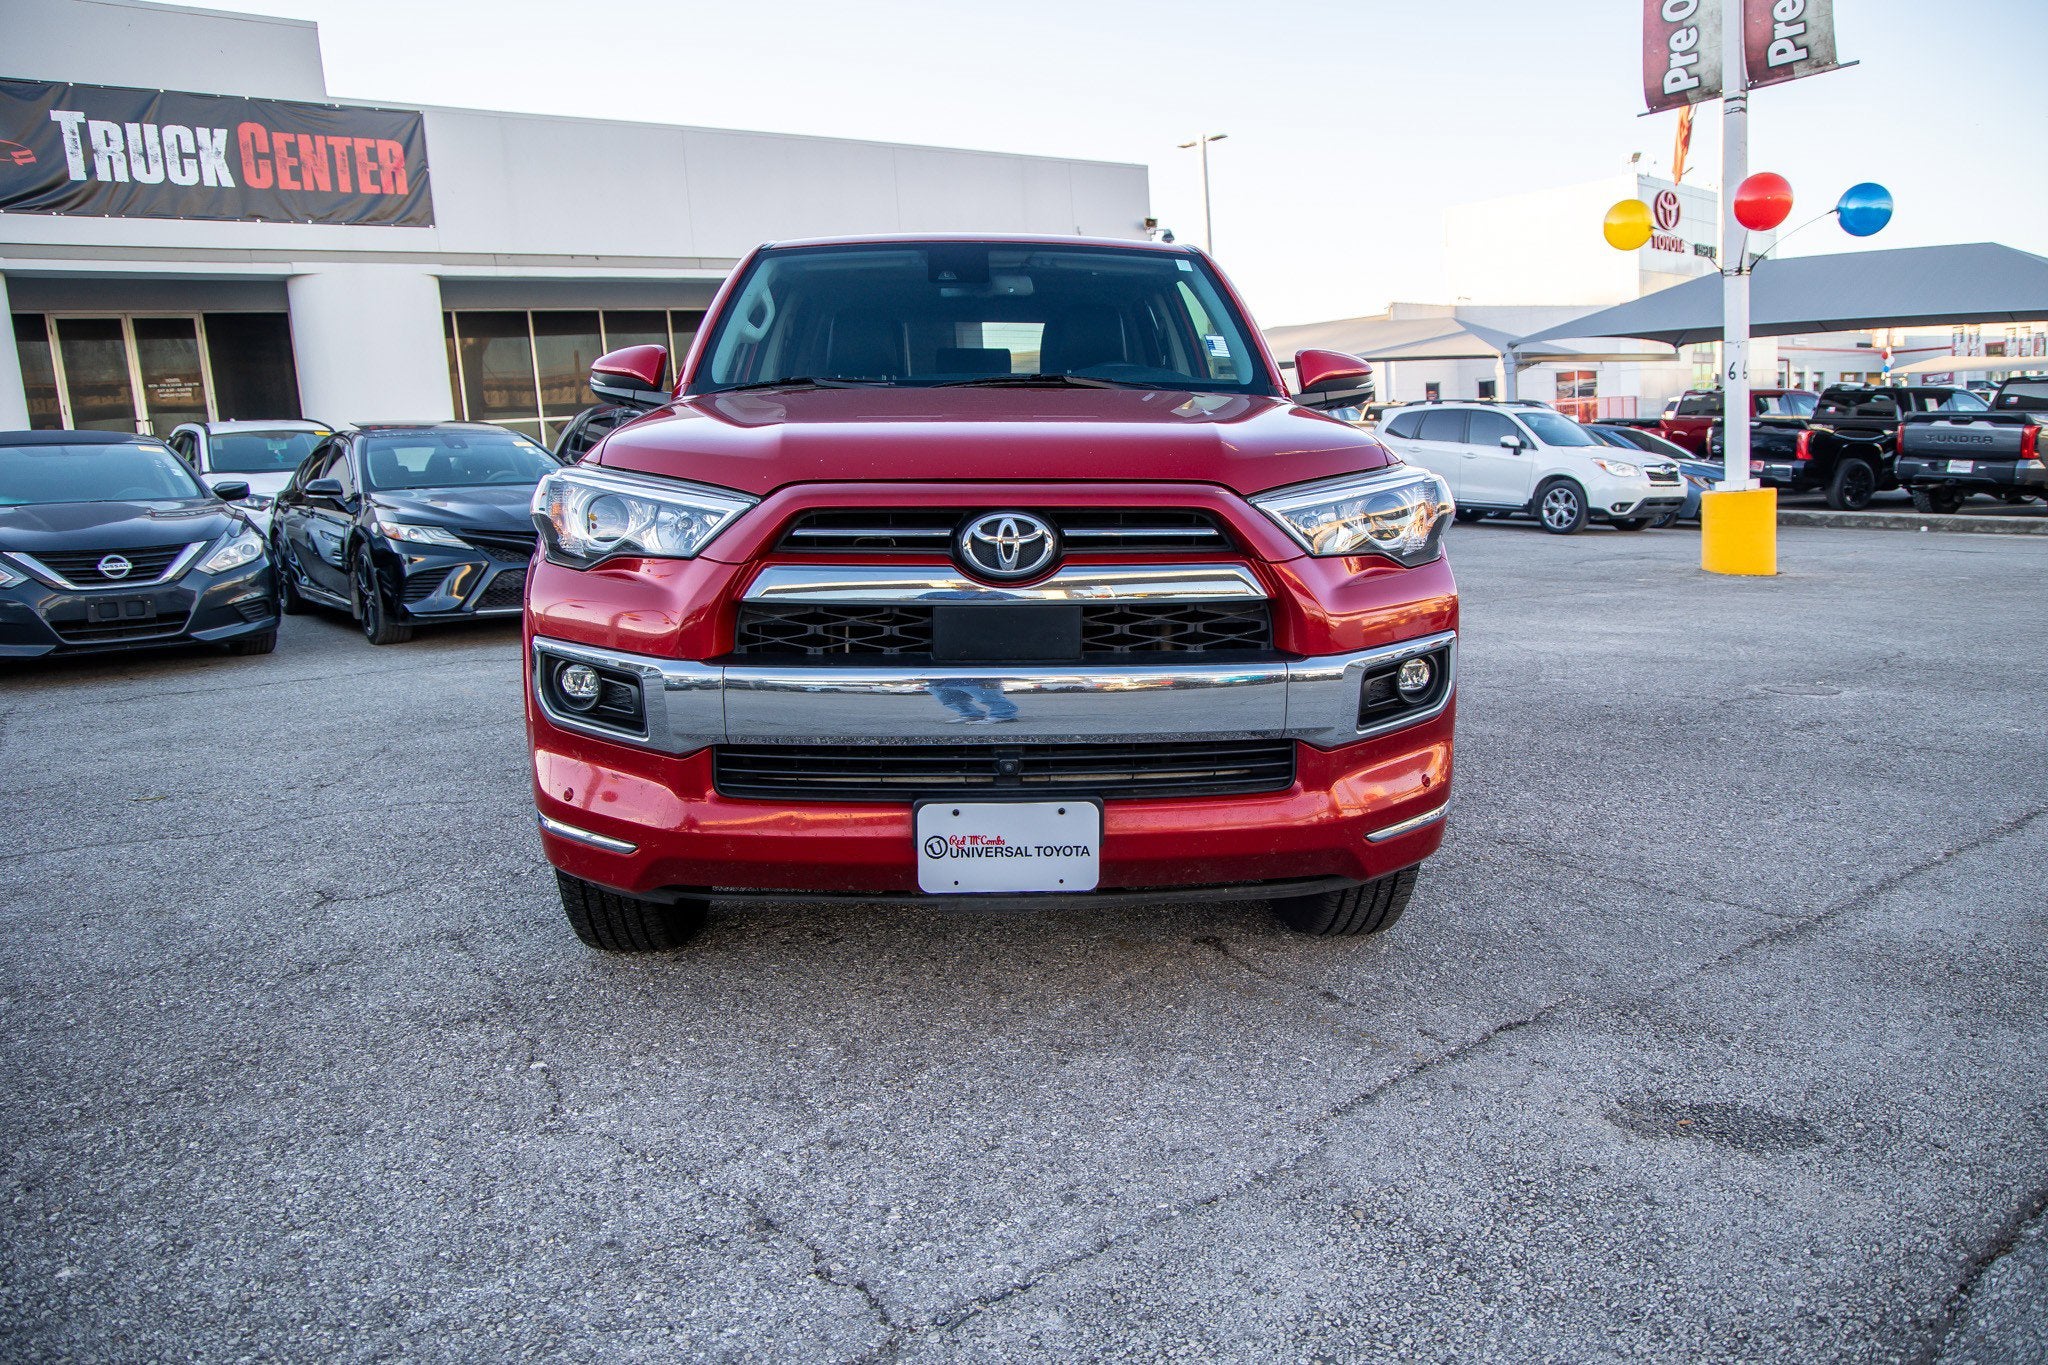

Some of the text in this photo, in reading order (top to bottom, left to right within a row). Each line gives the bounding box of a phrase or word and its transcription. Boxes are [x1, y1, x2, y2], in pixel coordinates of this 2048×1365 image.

[1767, 0, 1809, 68] Pre
[1663, 26, 1700, 95] Pre
[50, 109, 408, 195] TRUCK CENTER
[1650, 233, 1685, 254] TOYOTA
[1925, 434, 1994, 445] TUNDRA
[949, 834, 967, 850] Red
[949, 845, 1091, 858] UNIVERSAL TOYOTA
